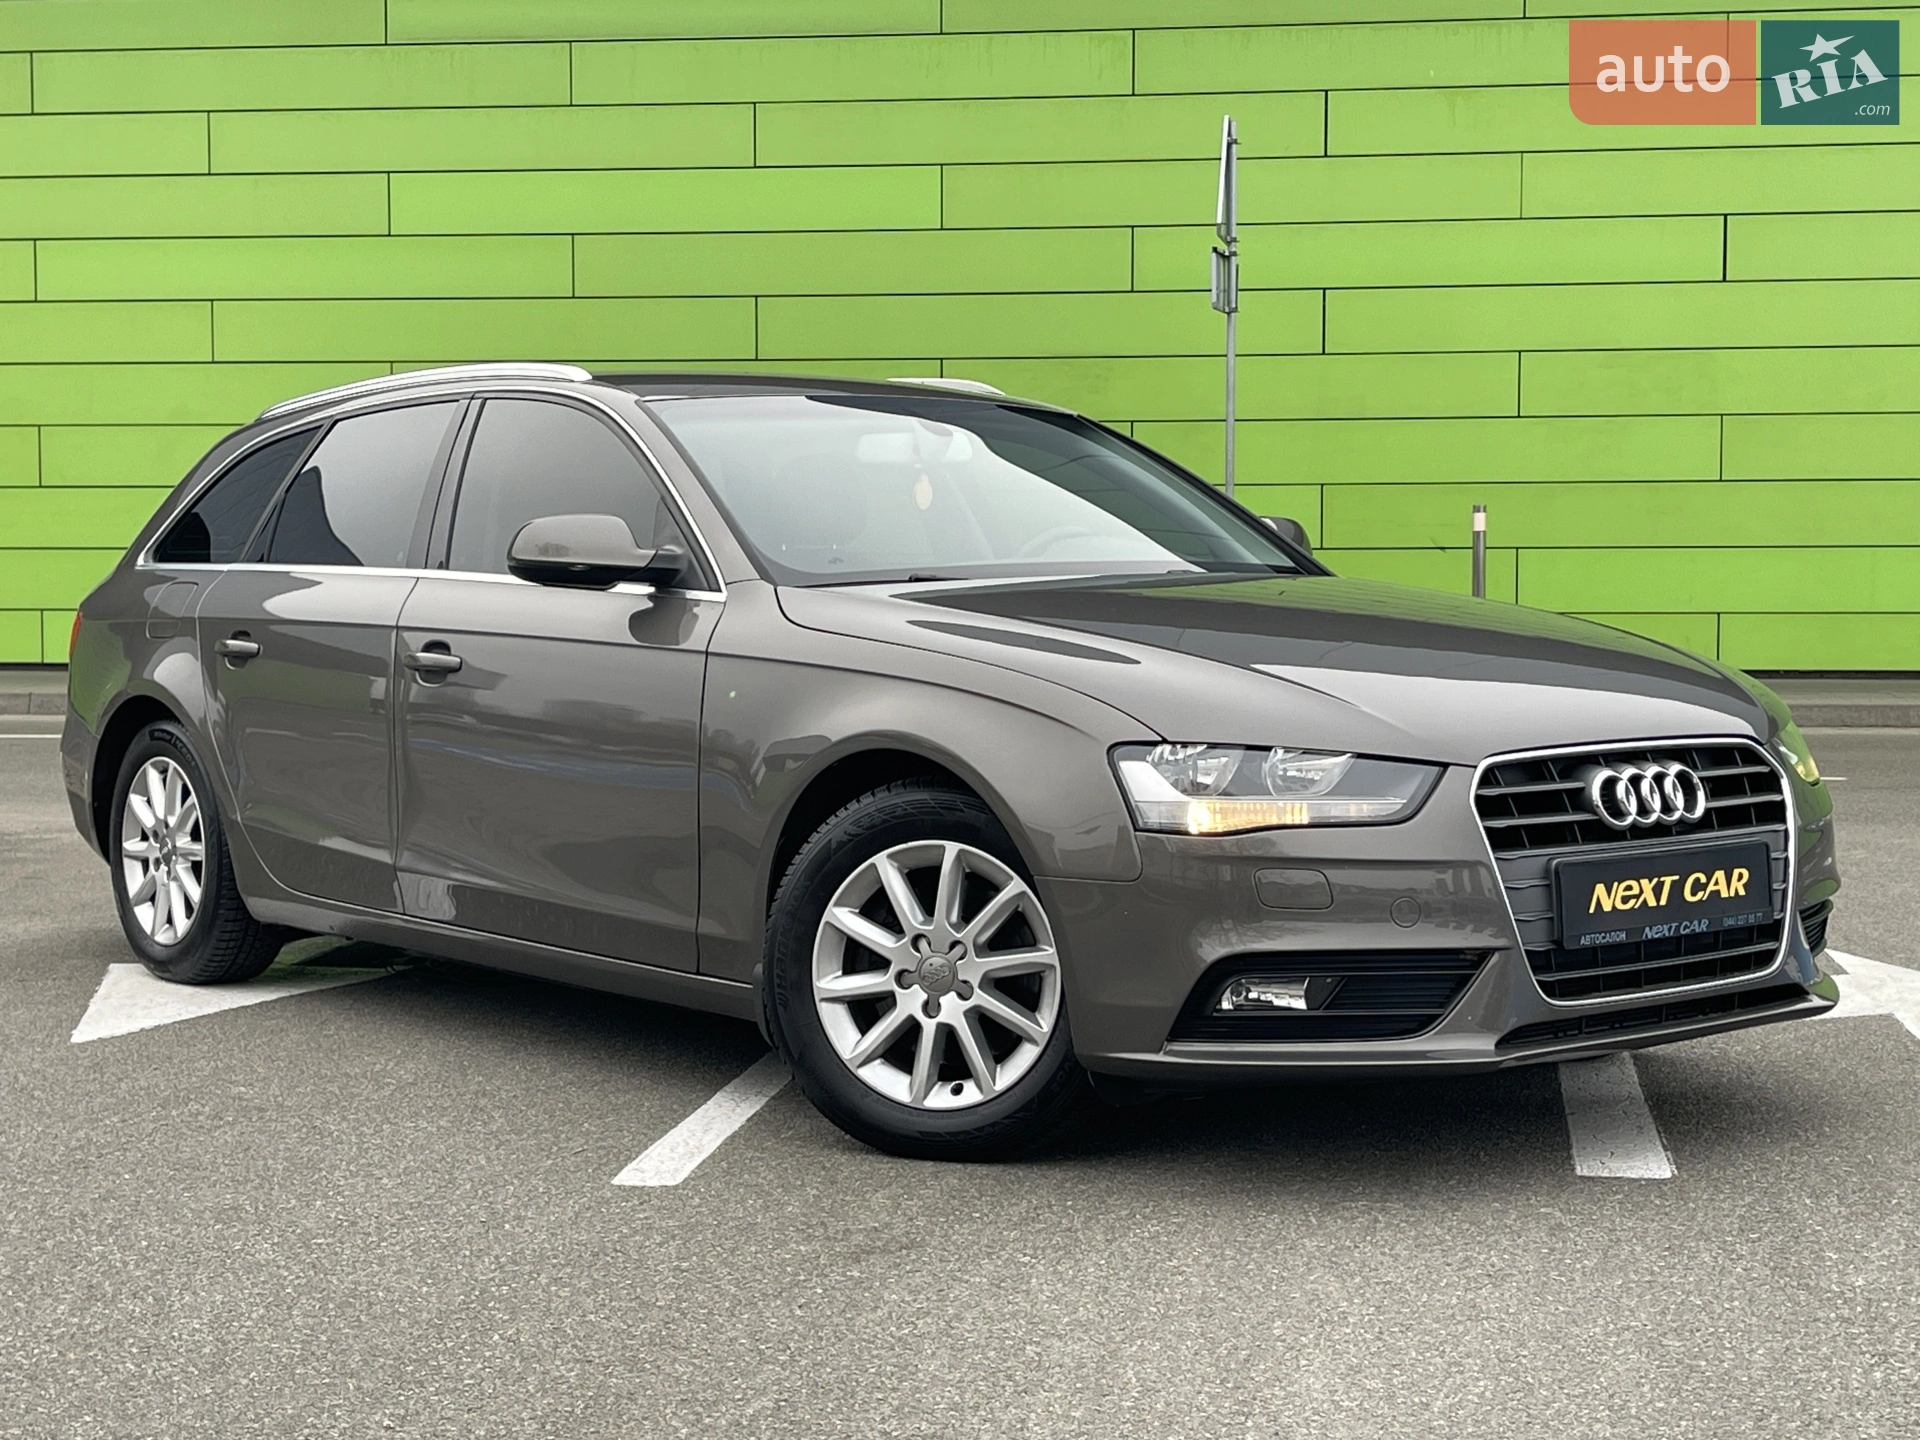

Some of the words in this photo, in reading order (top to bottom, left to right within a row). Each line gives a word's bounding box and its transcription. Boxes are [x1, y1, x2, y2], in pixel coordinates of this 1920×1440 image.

[1684, 867, 1749, 903] CAR
[1680, 919, 1709, 935] CAR
[1580, 931, 1626, 946] АВТОСАЛОН
